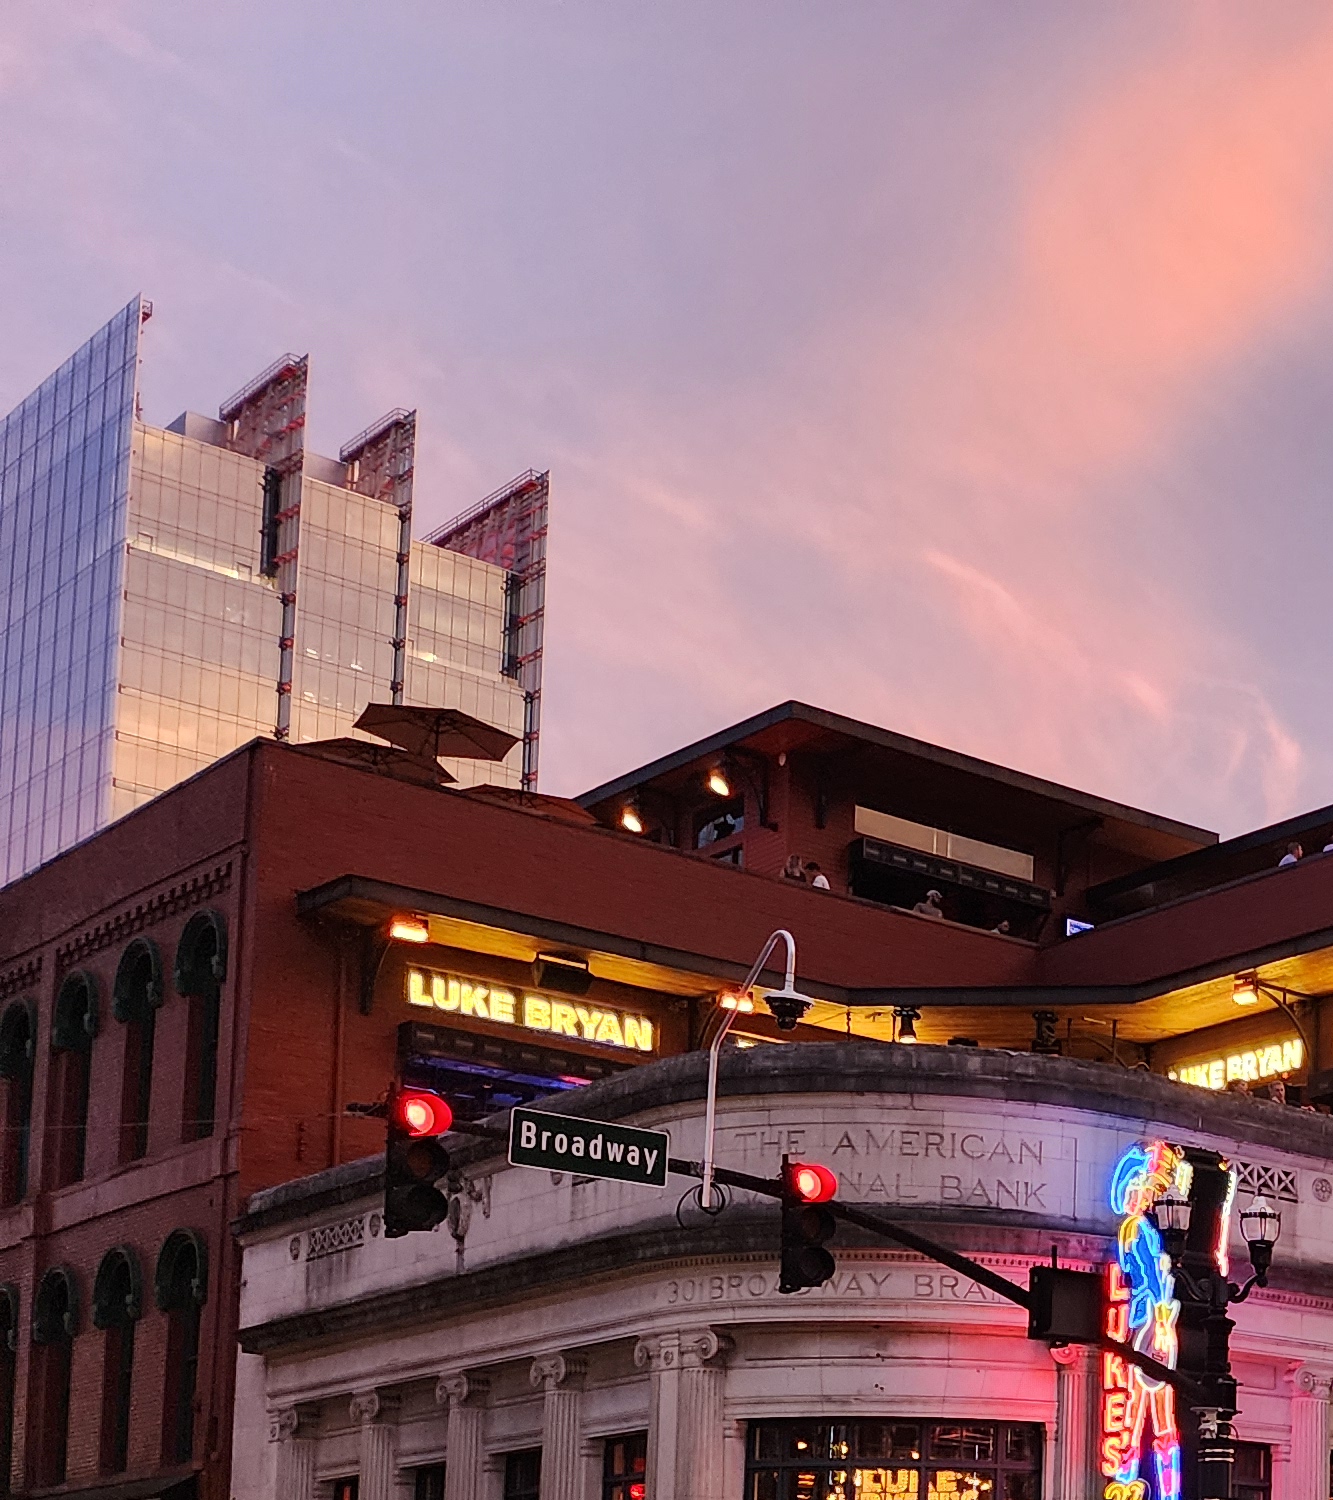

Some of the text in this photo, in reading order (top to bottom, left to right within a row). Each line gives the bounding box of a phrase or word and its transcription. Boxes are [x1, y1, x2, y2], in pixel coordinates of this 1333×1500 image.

[407, 970, 654, 1052] LUKE BRYAN
[1226, 1038, 1304, 1083] BRYAN
[520, 1120, 658, 1175] Broadway
[734, 1129, 1044, 1165] THE AMERICAN
[940, 1174, 1047, 1209] BANK
[709, 1272, 891, 1300] BROWAY
